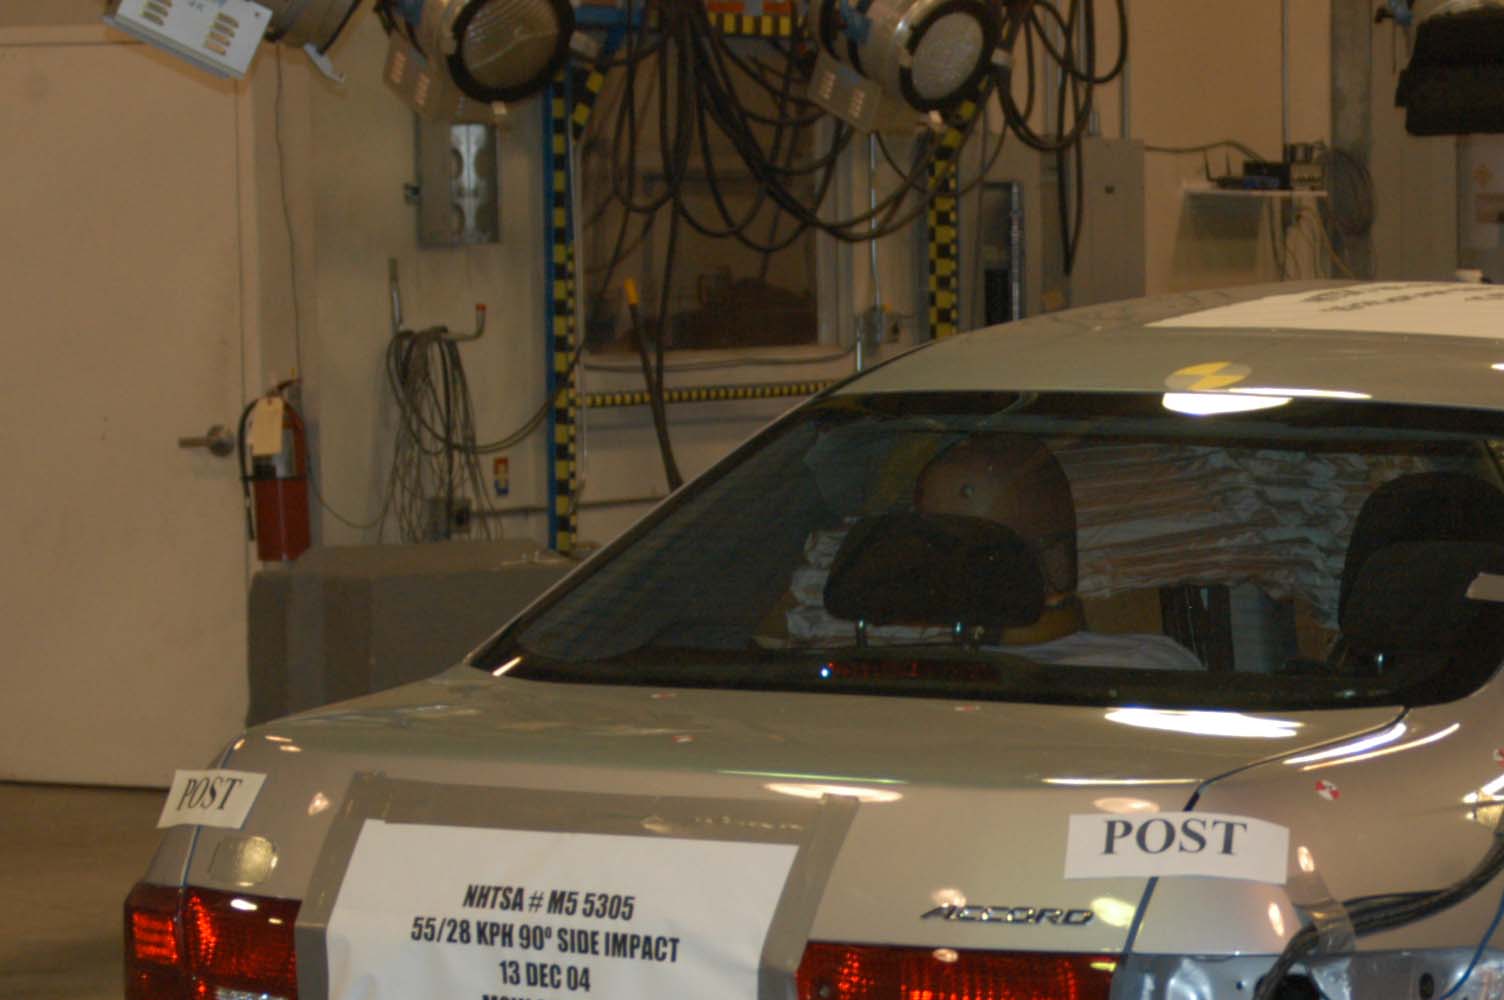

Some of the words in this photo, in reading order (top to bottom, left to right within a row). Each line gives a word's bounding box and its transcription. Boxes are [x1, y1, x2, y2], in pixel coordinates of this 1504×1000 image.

[175, 775, 244, 812] POST
[1101, 817, 1248, 857] POST
[462, 883, 525, 912] NHTSA
[528, 889, 545, 913] #
[547, 889, 579, 917] M5
[581, 892, 636, 921] 5305
[920, 904, 1096, 926] ACCORD
[411, 916, 472, 945] 55/28
[476, 919, 515, 948] KPH
[557, 927, 601, 956] SIDE
[604, 931, 681, 963] IMPACT
[499, 960, 521, 986] 13
[526, 962, 563, 990] DEC
[566, 965, 592, 993] 04
